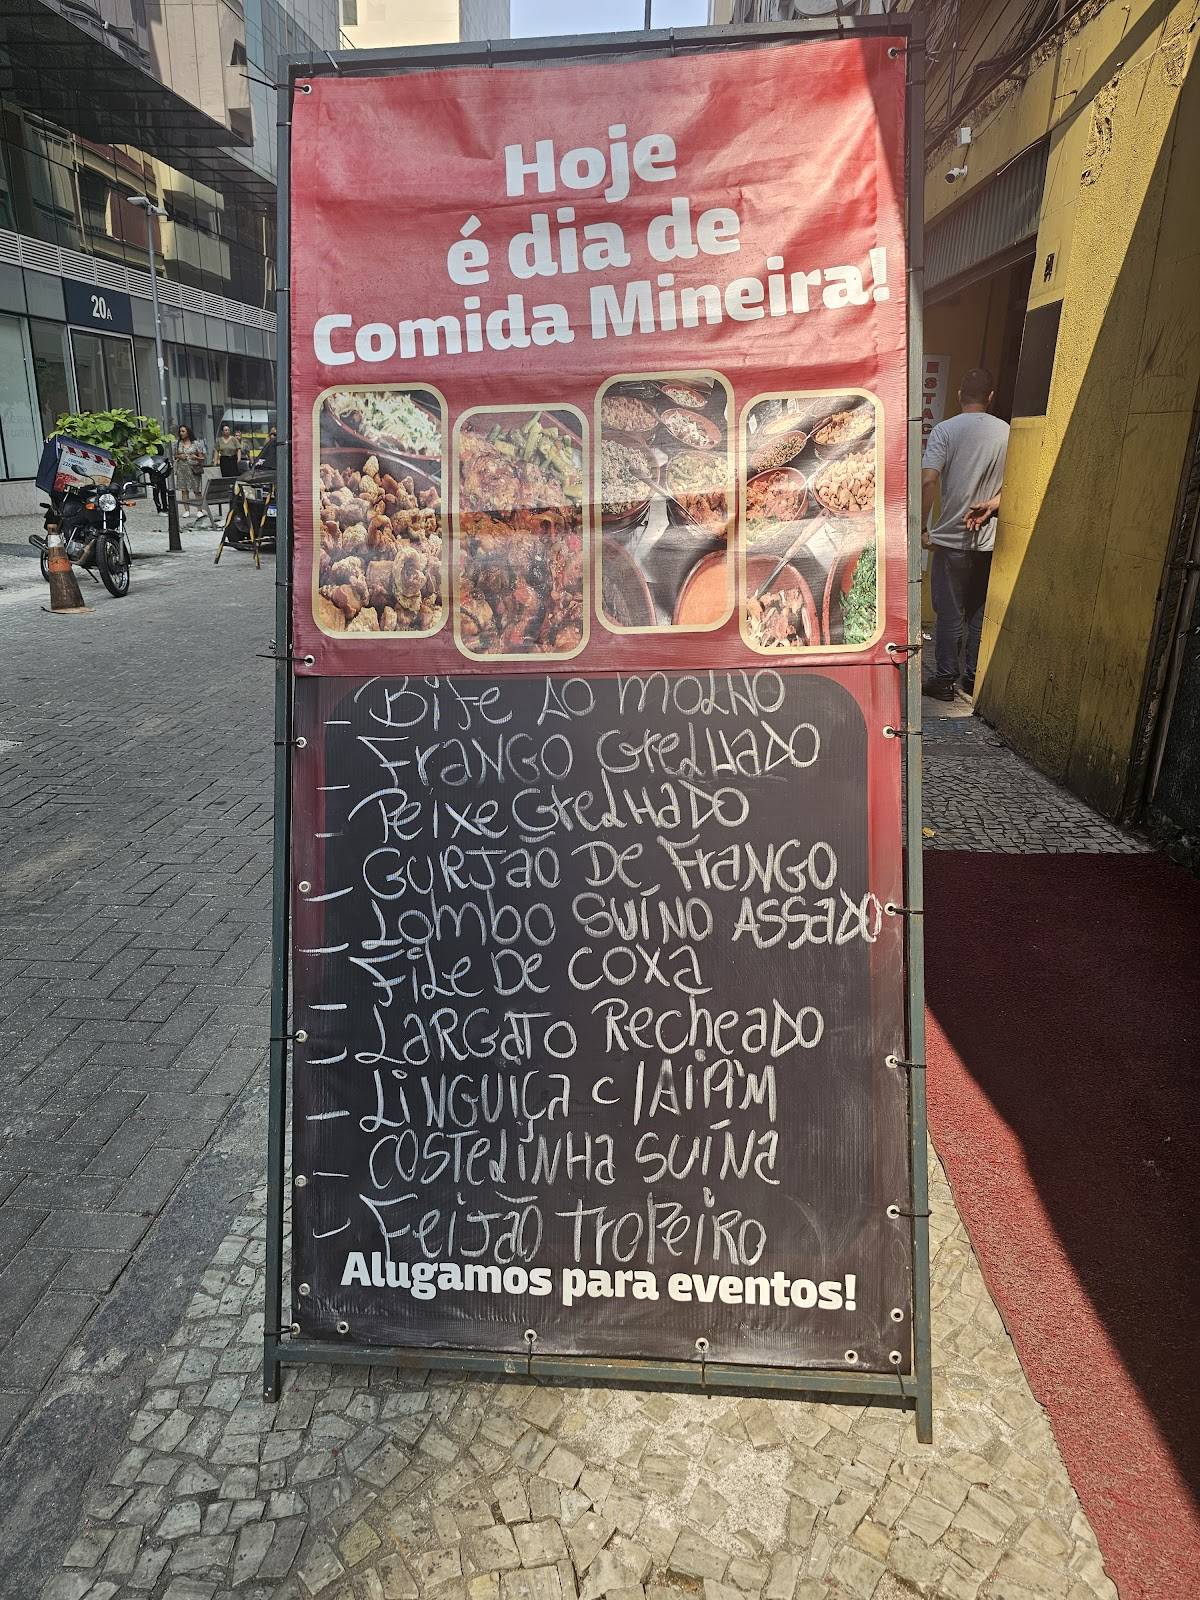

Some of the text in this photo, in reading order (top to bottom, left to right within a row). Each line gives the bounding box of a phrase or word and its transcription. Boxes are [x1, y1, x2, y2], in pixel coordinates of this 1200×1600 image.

[504, 123, 677, 203] Hoje
[447, 198, 740, 286] é dia de
[90, 294, 113, 321] 20A
[313, 247, 891, 366] Comida Mineira!
[537, 675, 597, 726] AO
[340, 1250, 857, 1311] Alugamos para eventos!
